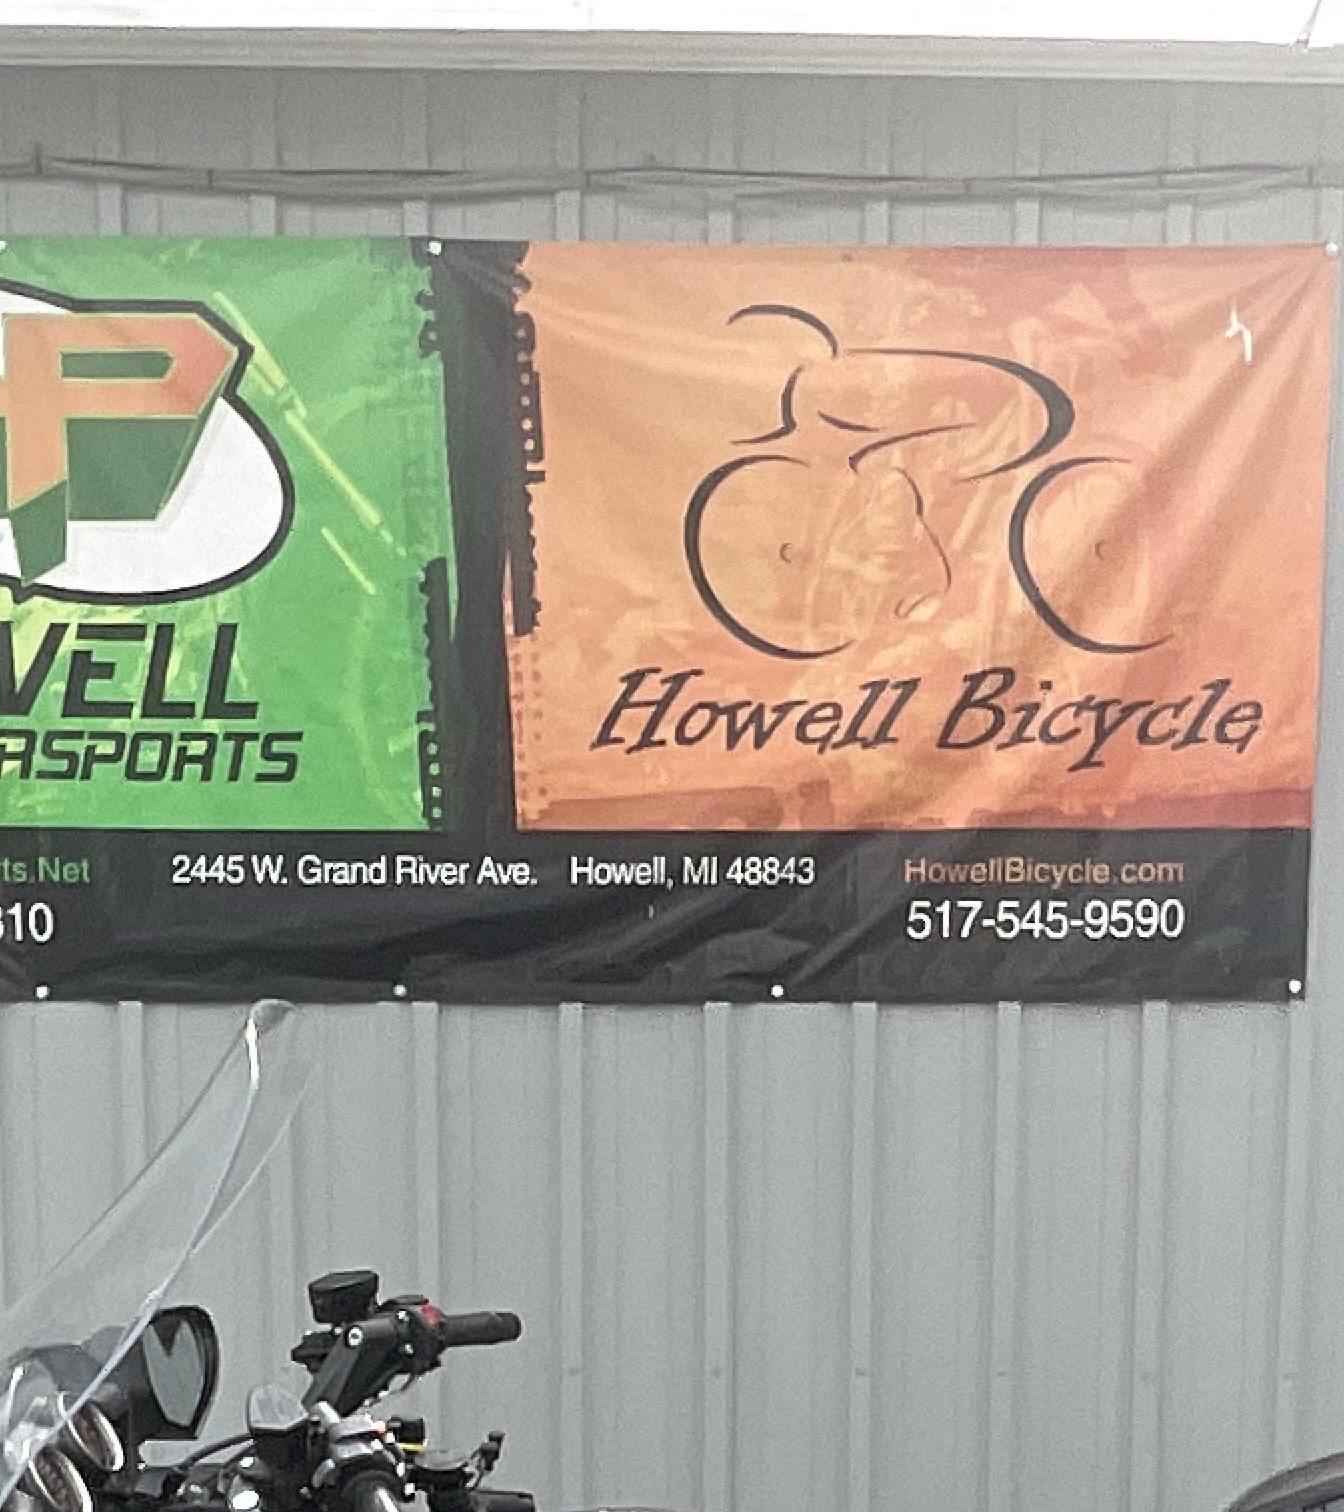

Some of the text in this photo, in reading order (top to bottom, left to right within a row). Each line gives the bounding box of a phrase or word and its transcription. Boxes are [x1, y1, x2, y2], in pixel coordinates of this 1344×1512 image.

[590, 666, 1264, 771] Howell Bicycle
[171, 854, 816, 891] 2445 W. Grand River Ave. Howell, MI 48843
[904, 857, 1185, 889] HowellBicycle.com
[906, 898, 1185, 940] 517-545-9590
